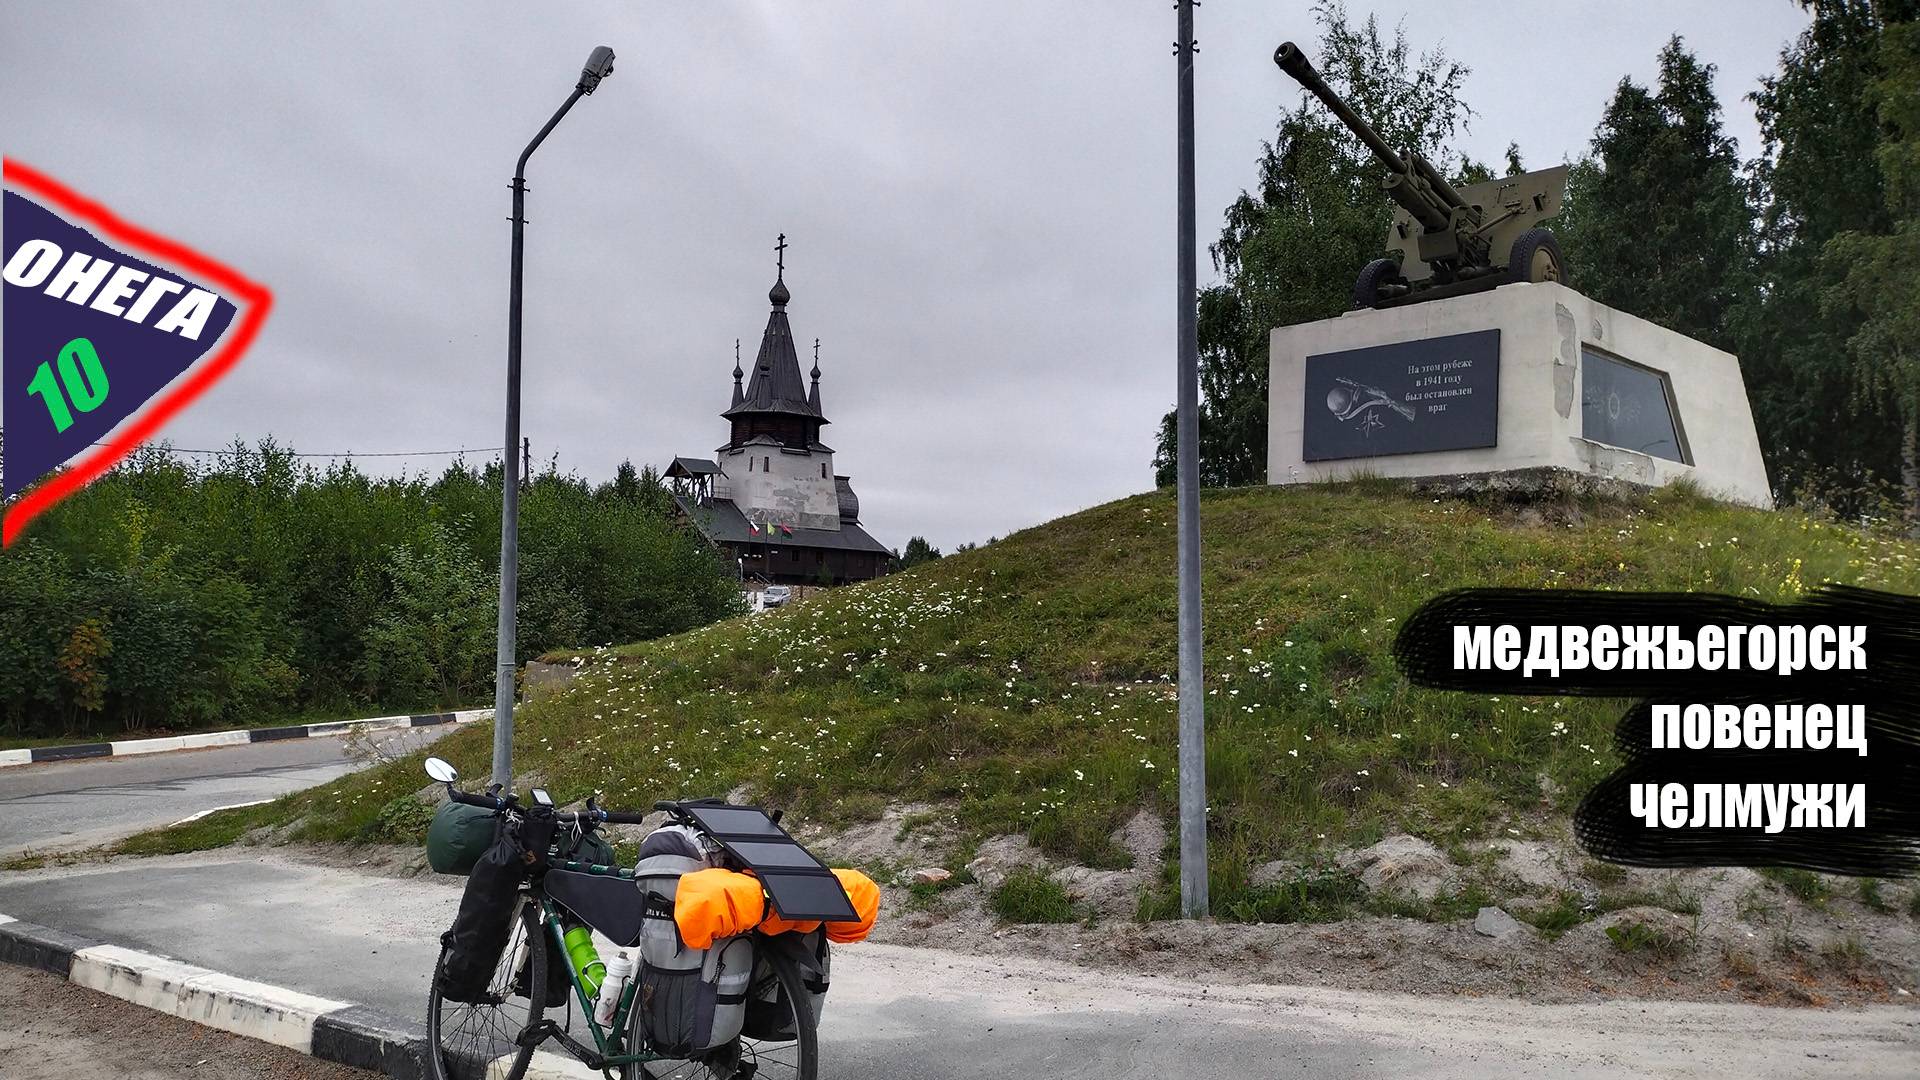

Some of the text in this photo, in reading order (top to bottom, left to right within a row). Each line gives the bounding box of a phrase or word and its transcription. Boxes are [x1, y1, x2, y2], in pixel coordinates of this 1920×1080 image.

[1408, 360, 1473, 374] На этом рубеже
[1424, 376, 1441, 386] 1941
[1444, 375, 1462, 385] году
[1405, 387, 1472, 401] был остановлен
[1428, 404, 1447, 414] враг
